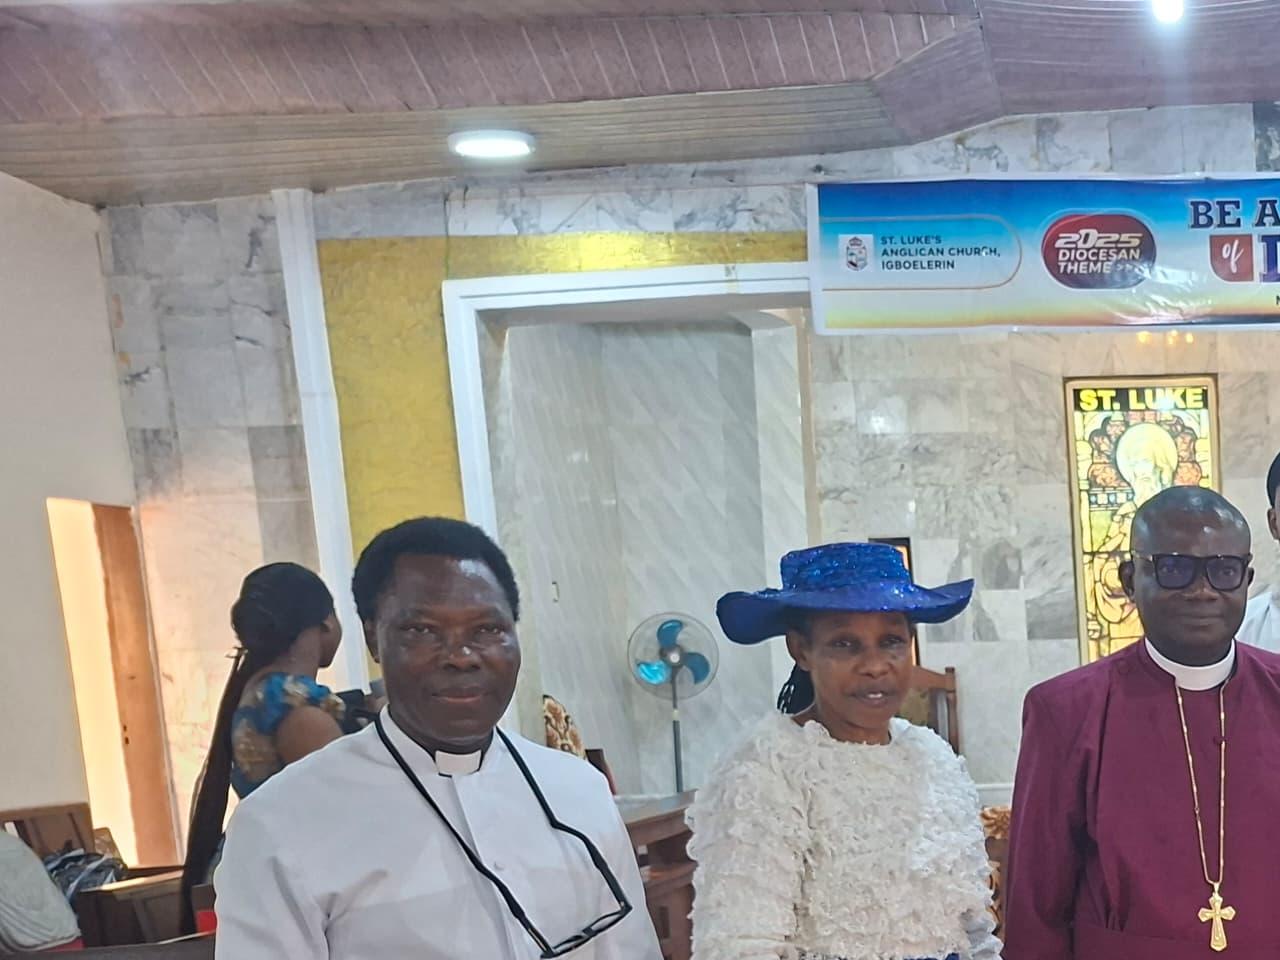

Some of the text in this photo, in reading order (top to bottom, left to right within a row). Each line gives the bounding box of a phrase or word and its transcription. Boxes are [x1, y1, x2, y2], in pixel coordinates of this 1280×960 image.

[1189, 200, 1241, 228] BE
[881, 236, 942, 245] ST. LUKE'S
[1055, 229, 1142, 248] 2025
[881, 248, 944, 257] ANGLICAN
[1058, 249, 1140, 261] DIOCESAN
[1222, 239, 1244, 273] of
[882, 260, 955, 270] IGBOELERIN
[1058, 262, 1112, 274] THEME
[1079, 387, 1203, 411] ST. LUKE
